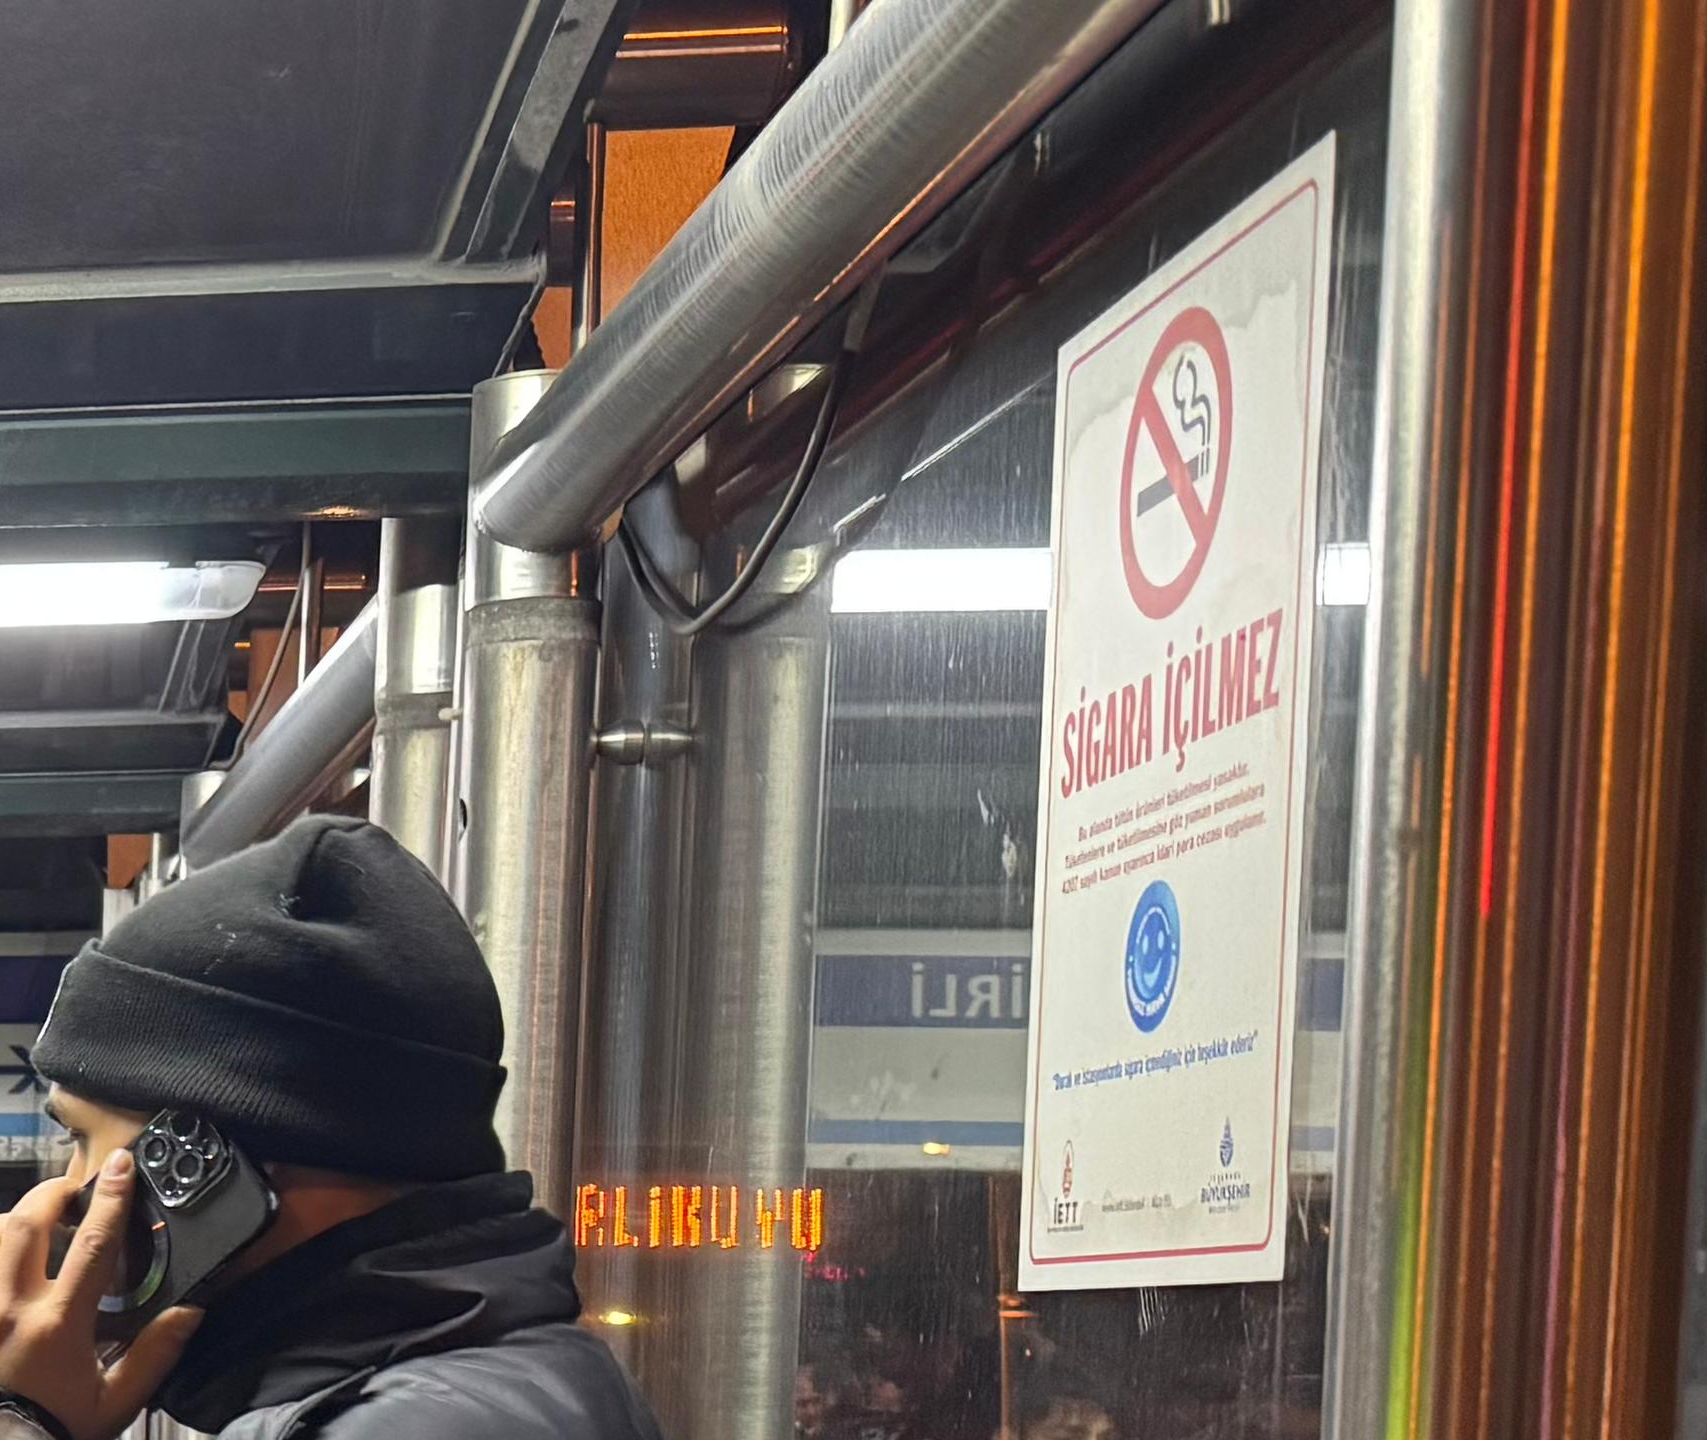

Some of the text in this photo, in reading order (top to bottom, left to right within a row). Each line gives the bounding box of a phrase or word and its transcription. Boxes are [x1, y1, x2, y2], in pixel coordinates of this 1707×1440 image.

[1061, 608, 1284, 799] SİGARA İÇİLMEZ
[1053, 1197, 1079, 1225] İETT
